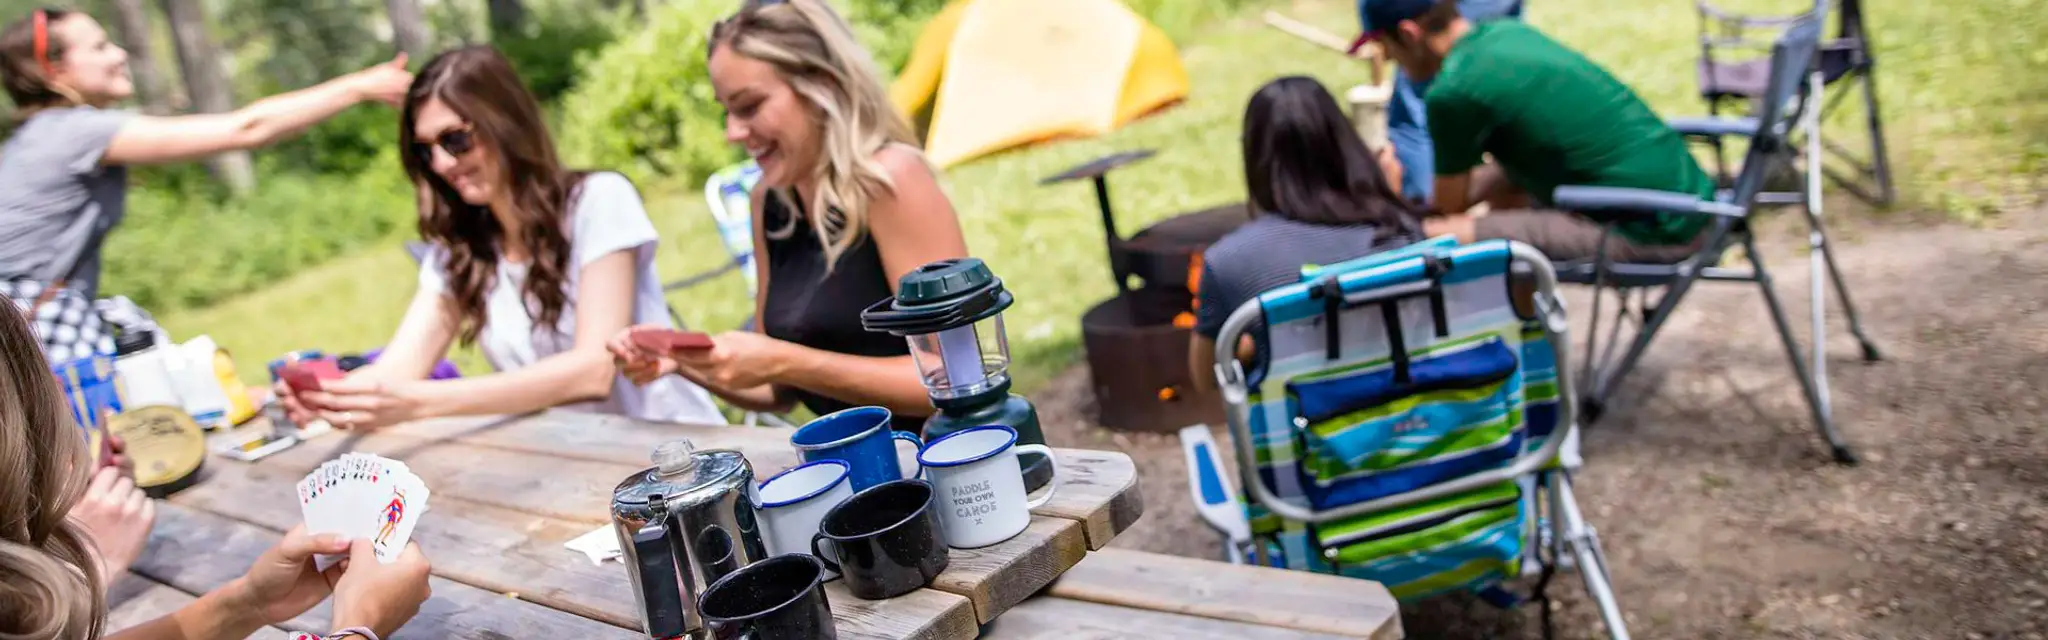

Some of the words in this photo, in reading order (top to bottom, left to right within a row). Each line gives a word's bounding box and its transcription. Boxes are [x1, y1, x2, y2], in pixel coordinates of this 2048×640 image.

[951, 480, 991, 497] PADDLE
[953, 497, 973, 506] YOUR
[975, 491, 995, 502] OWN
[956, 501, 997, 518] CANOE
